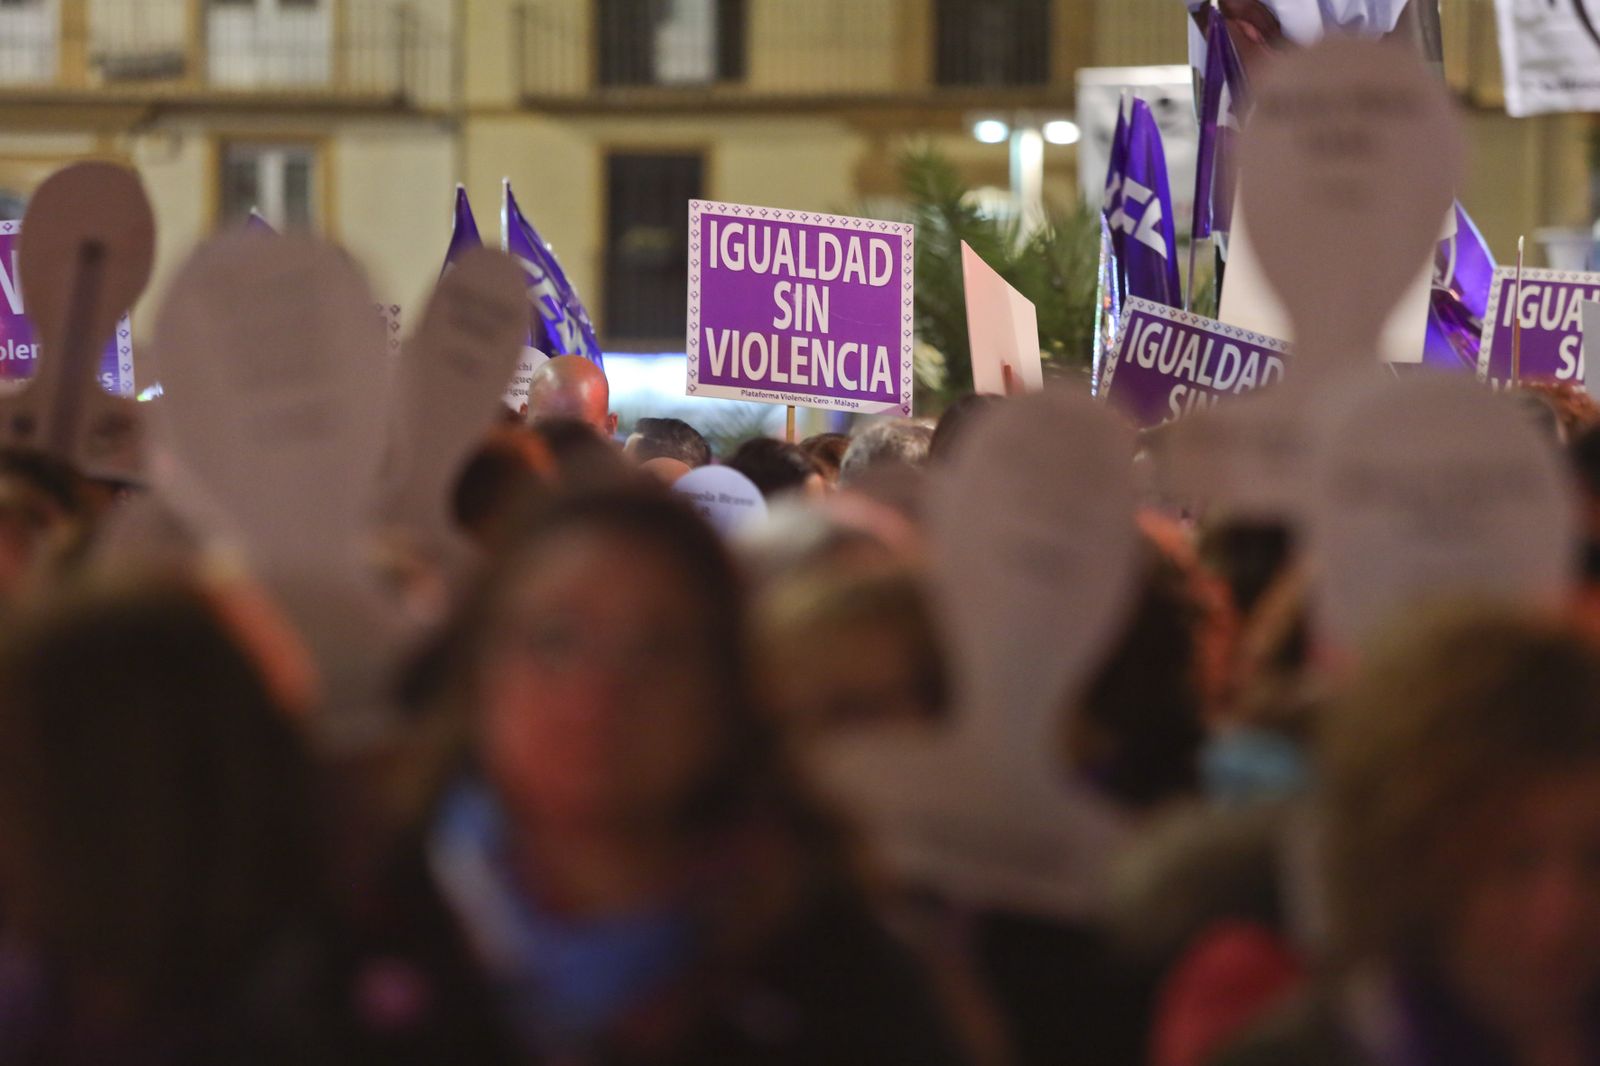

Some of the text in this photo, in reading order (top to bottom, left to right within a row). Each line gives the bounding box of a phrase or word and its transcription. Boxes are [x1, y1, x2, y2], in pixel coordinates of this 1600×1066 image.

[709, 220, 894, 287] IGUALDAD
[773, 280, 830, 334] SIN
[1502, 283, 1600, 333] IGUA
[705, 327, 894, 394] VIOLENCIA
[741, 389, 780, 400] Plataforma
[781, 393, 812, 404] Violencia
[813, 397, 829, 405] Cero
